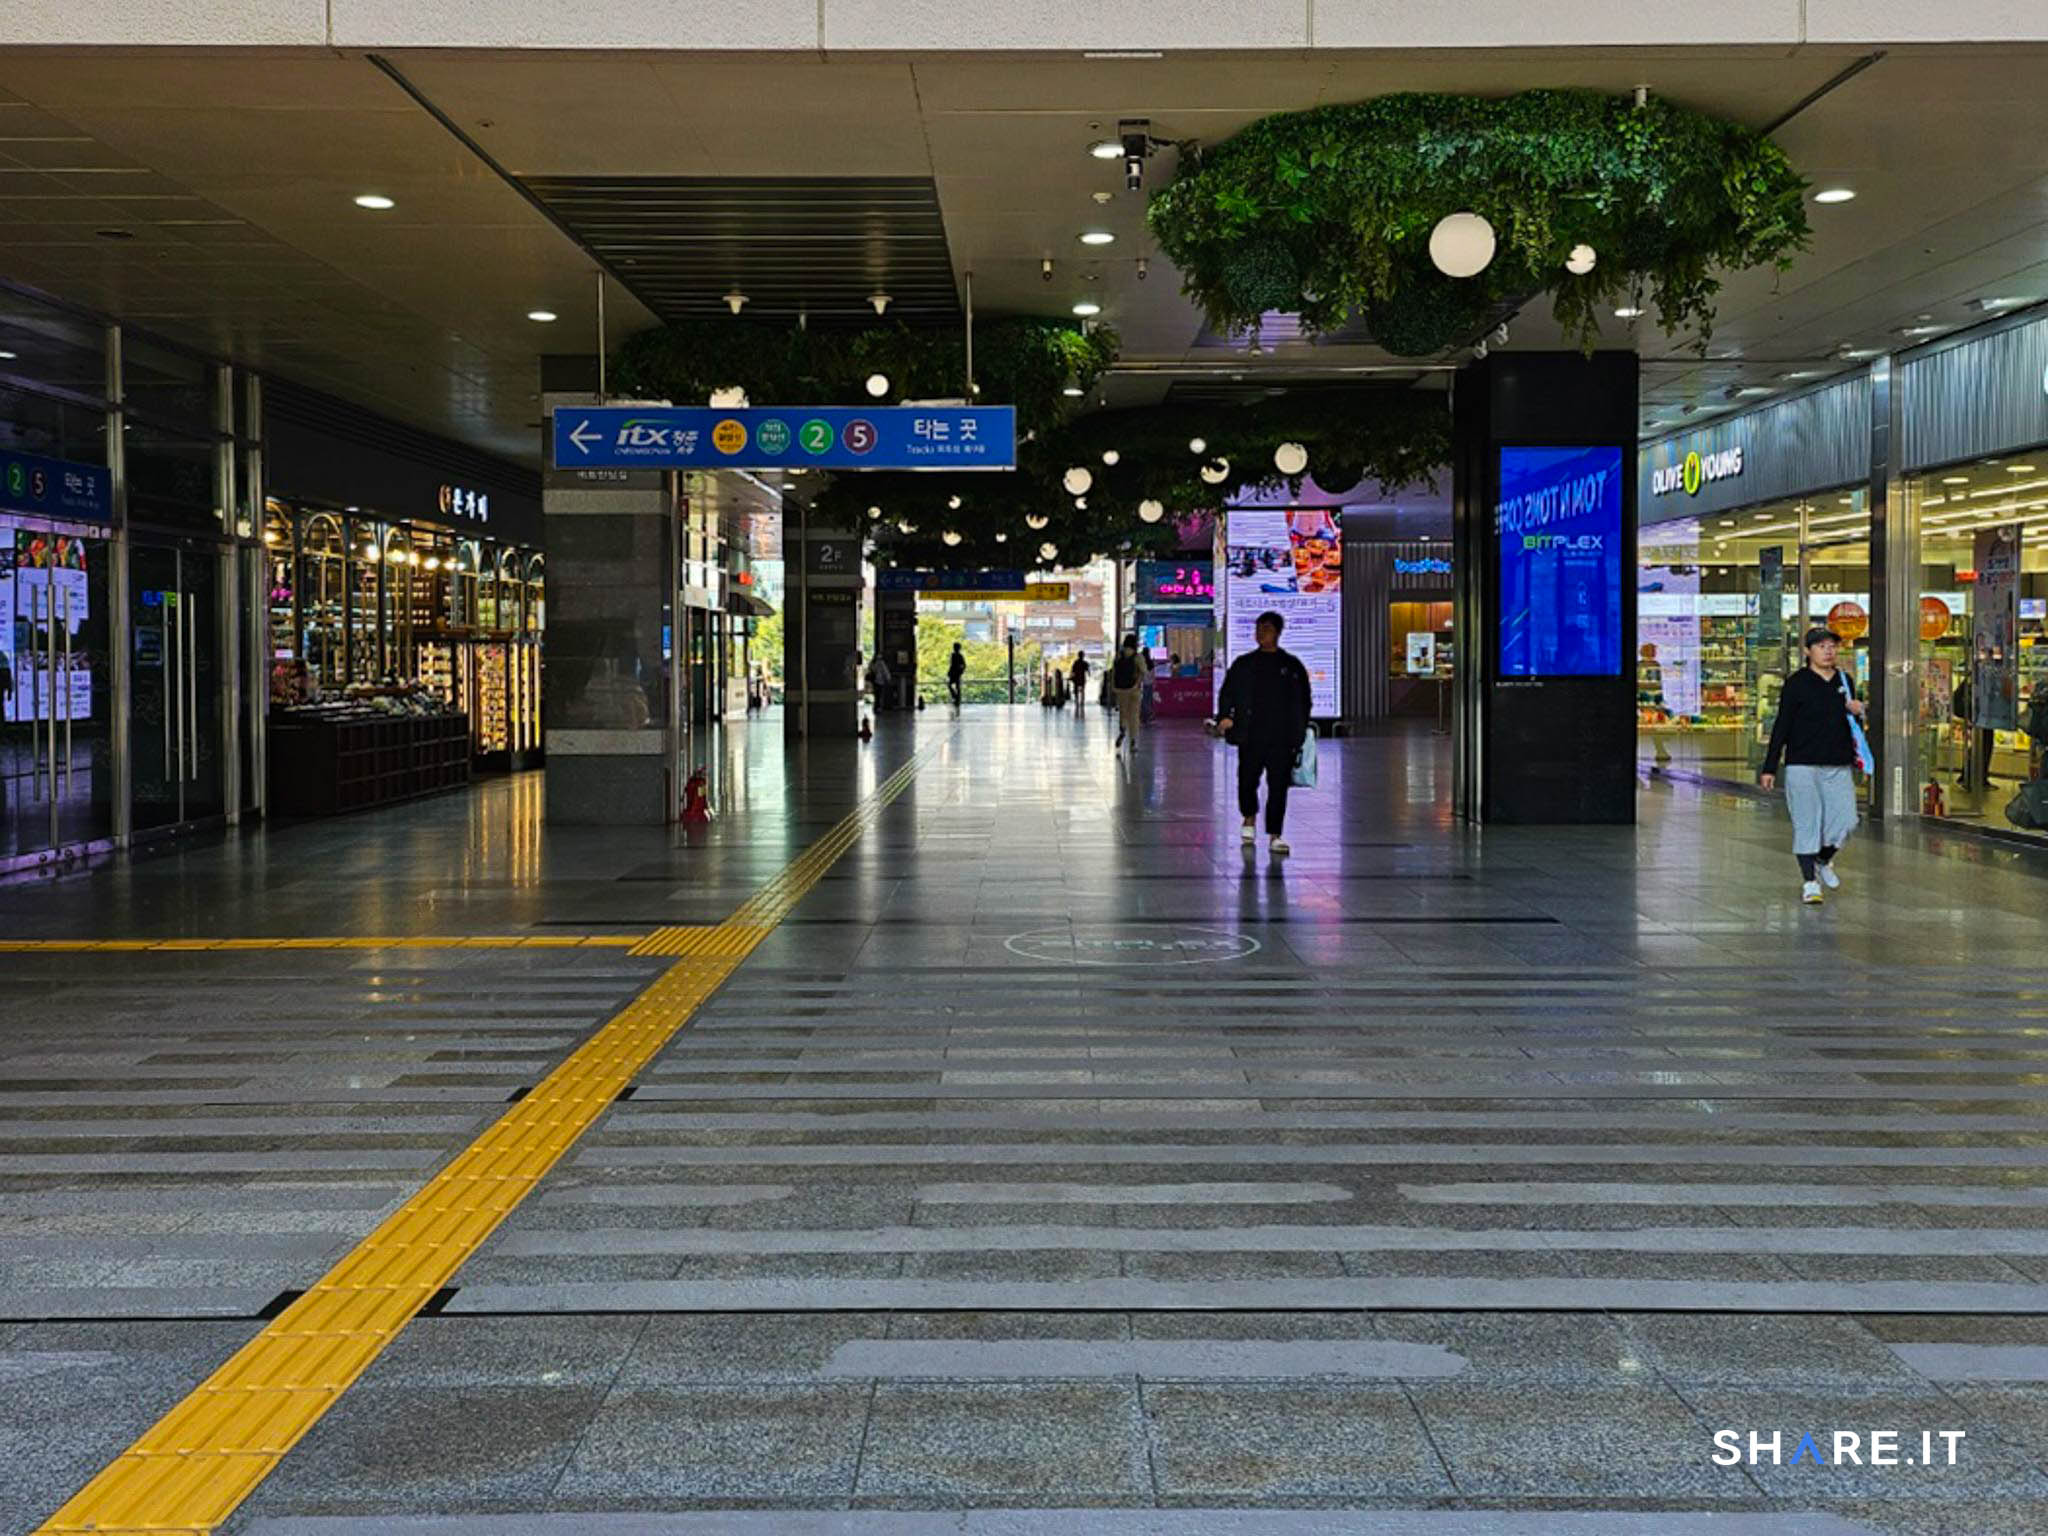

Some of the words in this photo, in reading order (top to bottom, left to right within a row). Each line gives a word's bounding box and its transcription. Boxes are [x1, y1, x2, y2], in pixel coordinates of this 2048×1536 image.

[810, 425, 824, 448] 2
[853, 425, 868, 448] 5
[914, 419, 950, 441] 타는
[960, 418, 978, 441] 곳
[1701, 446, 1744, 481] YOUNG
[1653, 463, 1684, 496] OLIVE
[1523, 535, 1604, 549] BITPLEX
[1809, 583, 1841, 593] CARE
